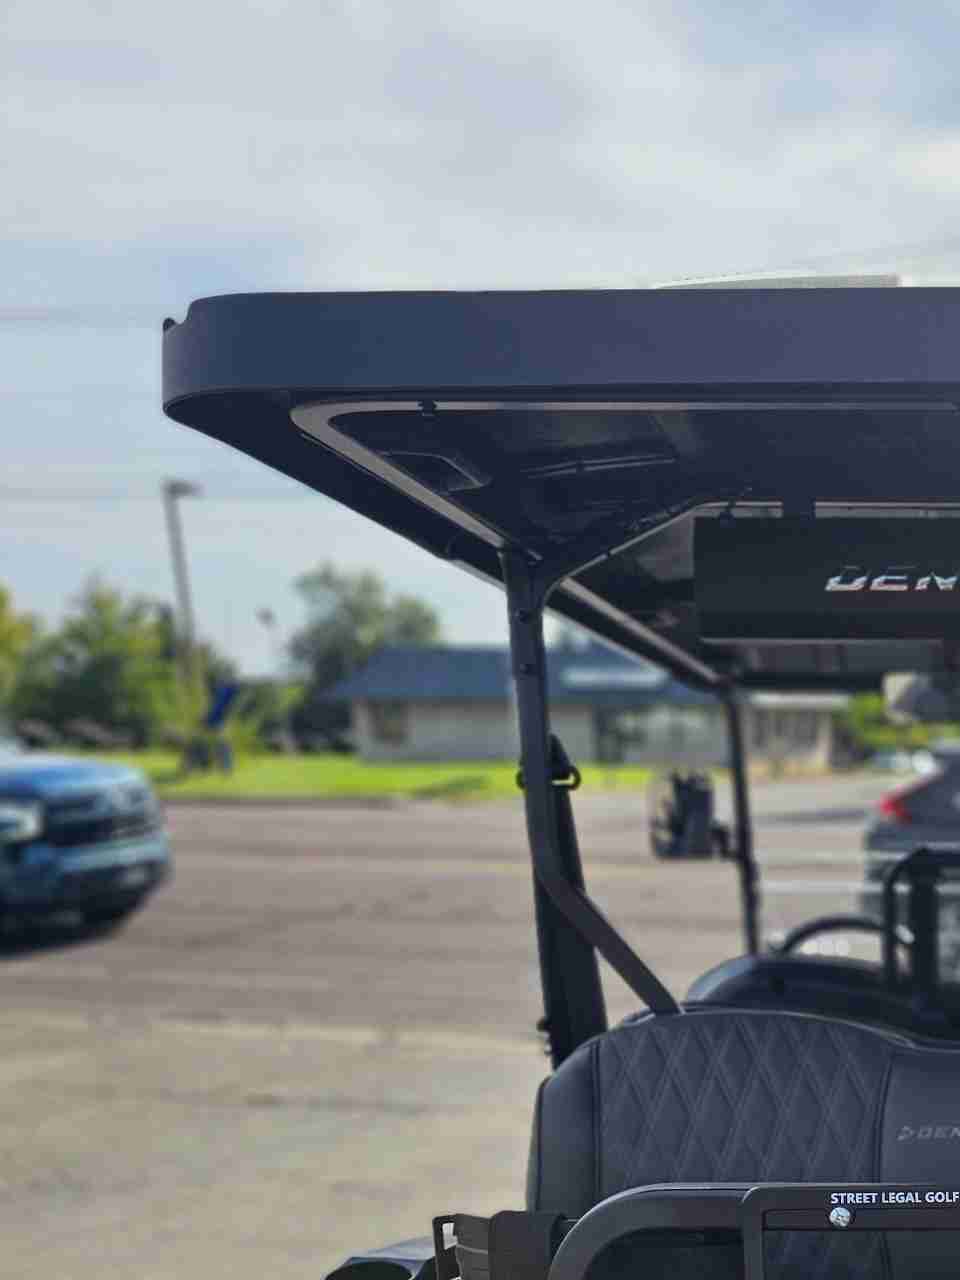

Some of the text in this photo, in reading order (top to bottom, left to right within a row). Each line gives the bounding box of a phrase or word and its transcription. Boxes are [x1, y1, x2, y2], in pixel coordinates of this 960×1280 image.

[830, 1192, 878, 1204] STREET
[881, 1191, 920, 1203] LEGAL
[924, 1191, 960, 1203] GOLF
